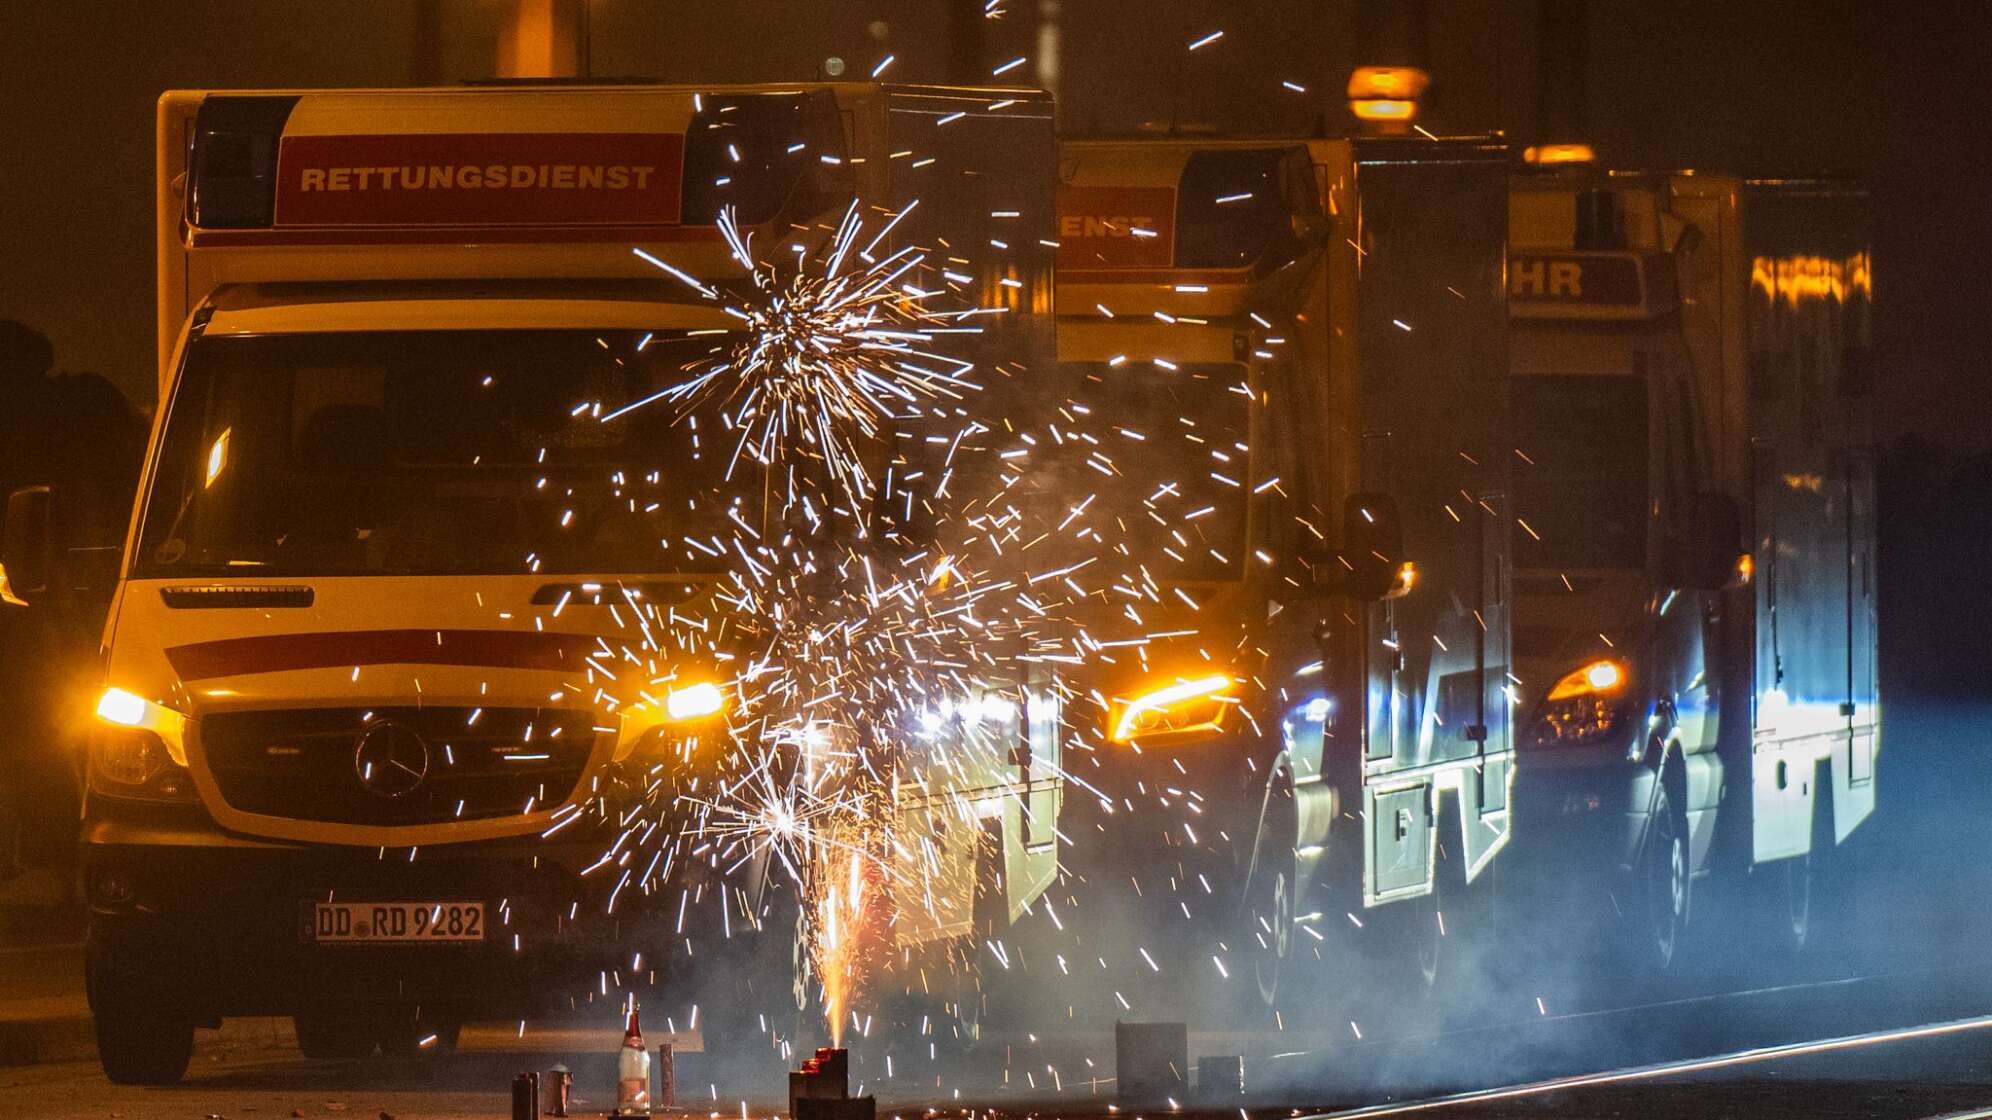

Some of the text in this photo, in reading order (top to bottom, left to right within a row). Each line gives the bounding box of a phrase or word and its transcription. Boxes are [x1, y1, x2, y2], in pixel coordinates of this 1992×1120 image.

[301, 165, 655, 192] RETTUNGSDIENST
[318, 906, 481, 936] DD RD 9282
